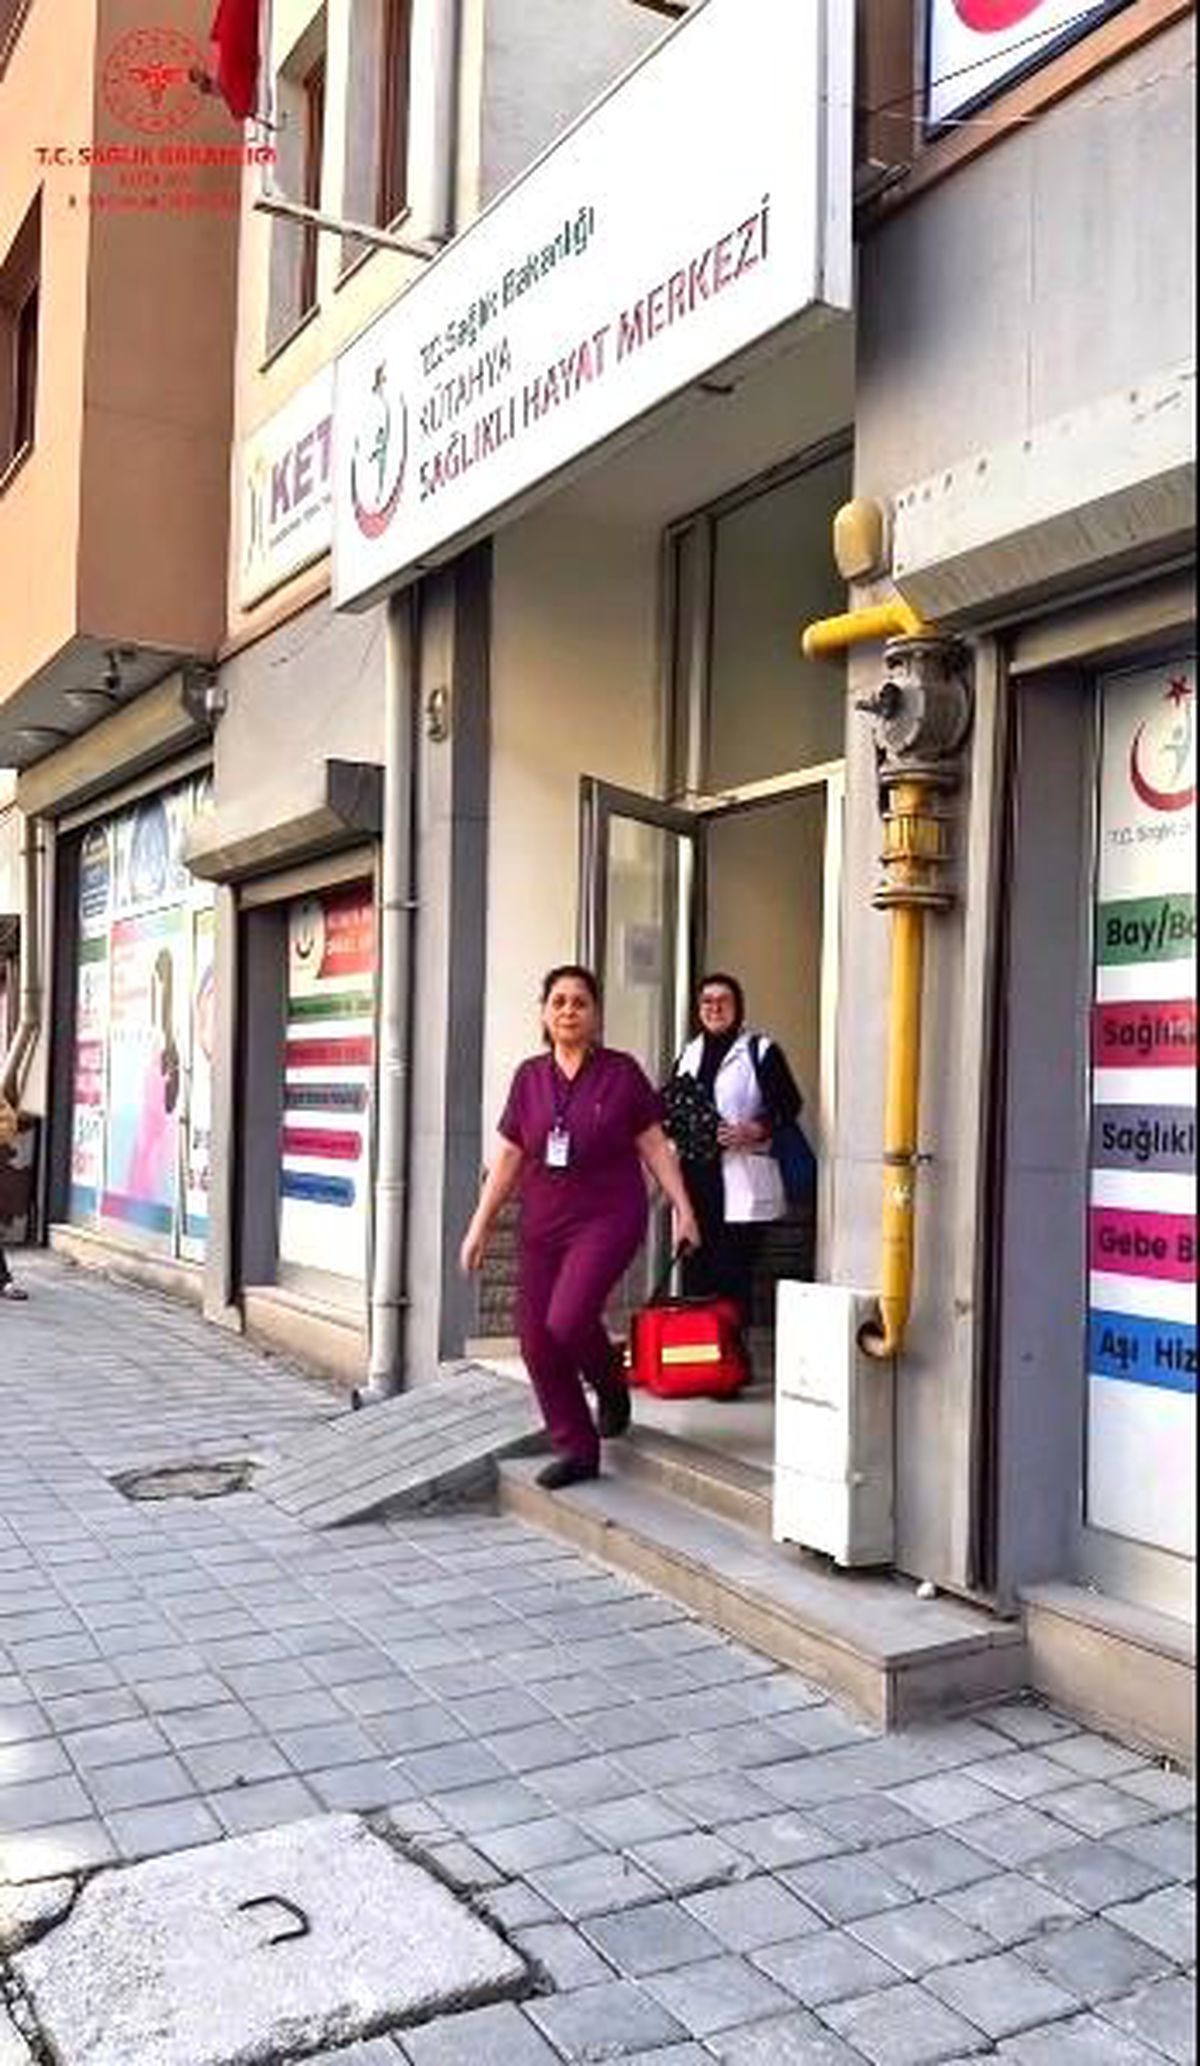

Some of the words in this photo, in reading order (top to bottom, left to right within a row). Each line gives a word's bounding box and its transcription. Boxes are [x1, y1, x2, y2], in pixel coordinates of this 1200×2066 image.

[419, 396, 516, 502] SAĞLIKLI
[523, 323, 612, 428] HAYAT
[616, 192, 770, 363] MERKEZİ
[1100, 1226, 1168, 1261] Gebe
